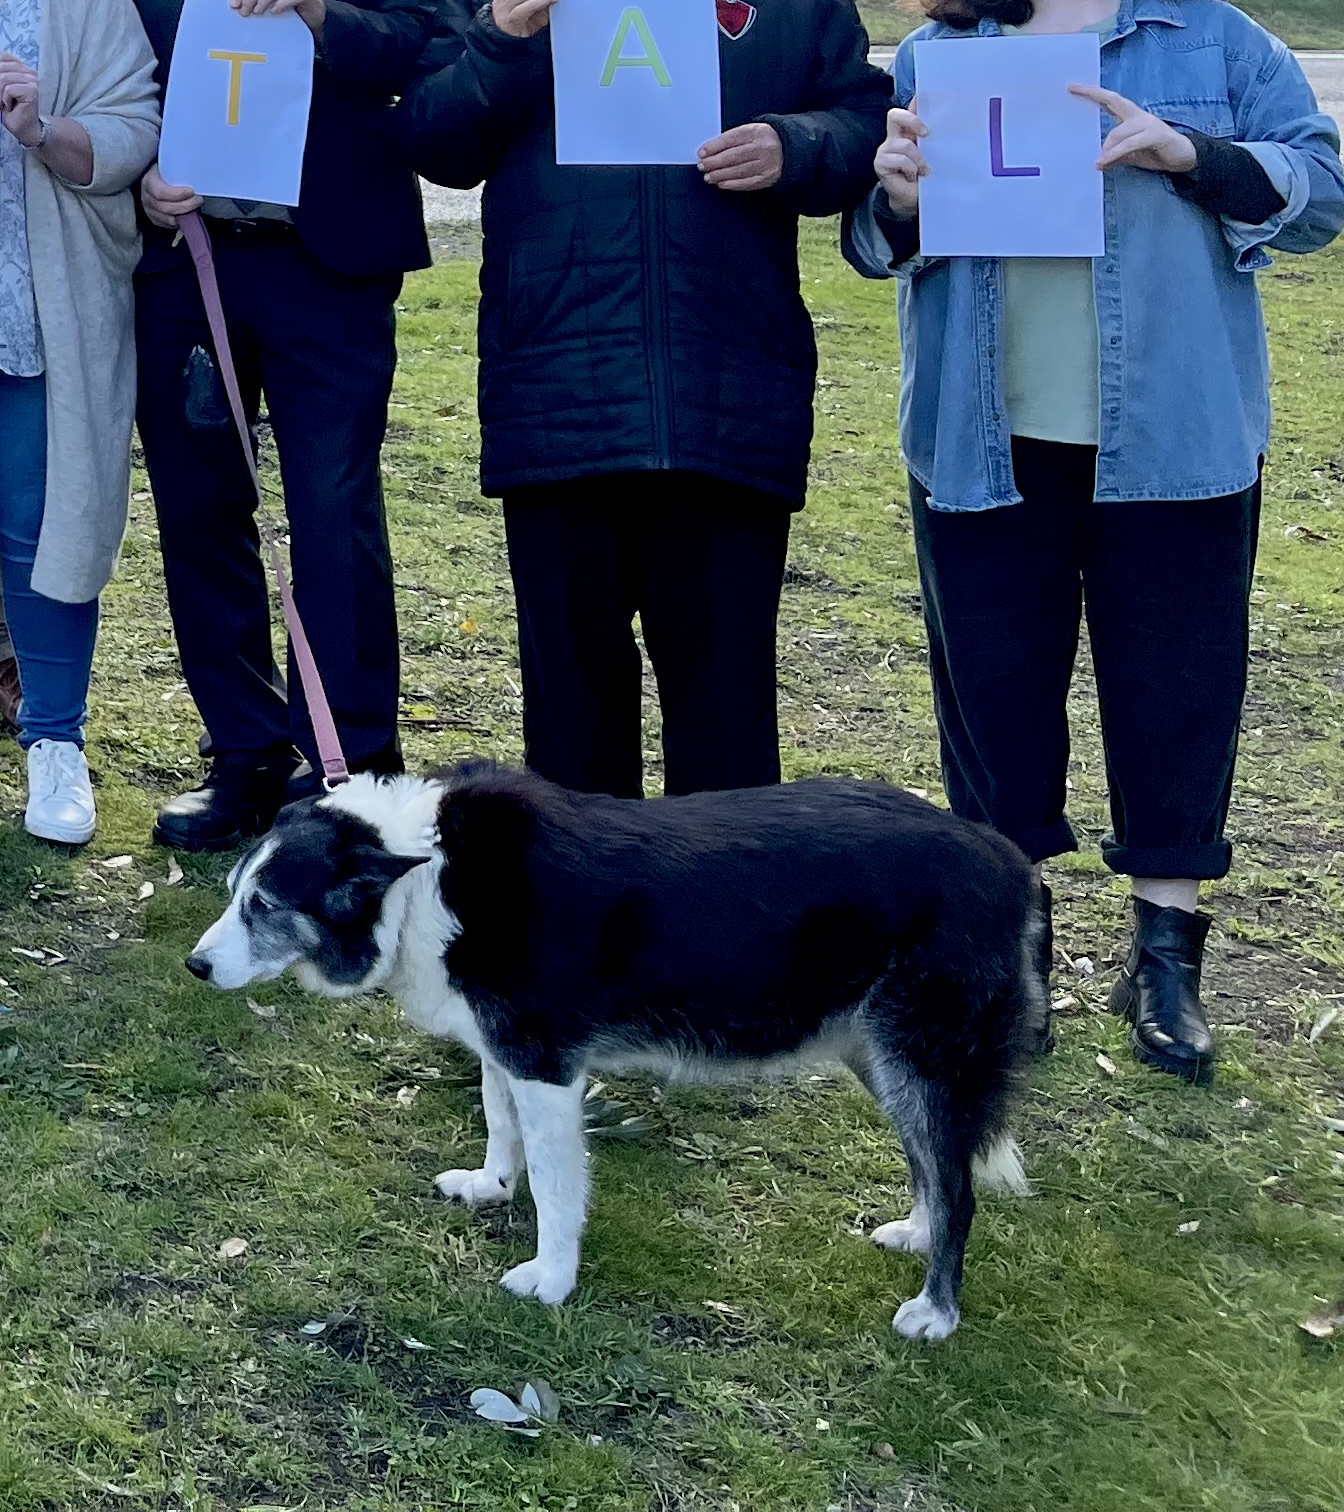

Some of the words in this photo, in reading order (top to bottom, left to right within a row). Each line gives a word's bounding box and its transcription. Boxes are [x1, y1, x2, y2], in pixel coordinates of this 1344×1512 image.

[207, 49, 268, 127] T
[600, 7, 672, 88] A
[989, 96, 1041, 178] L
